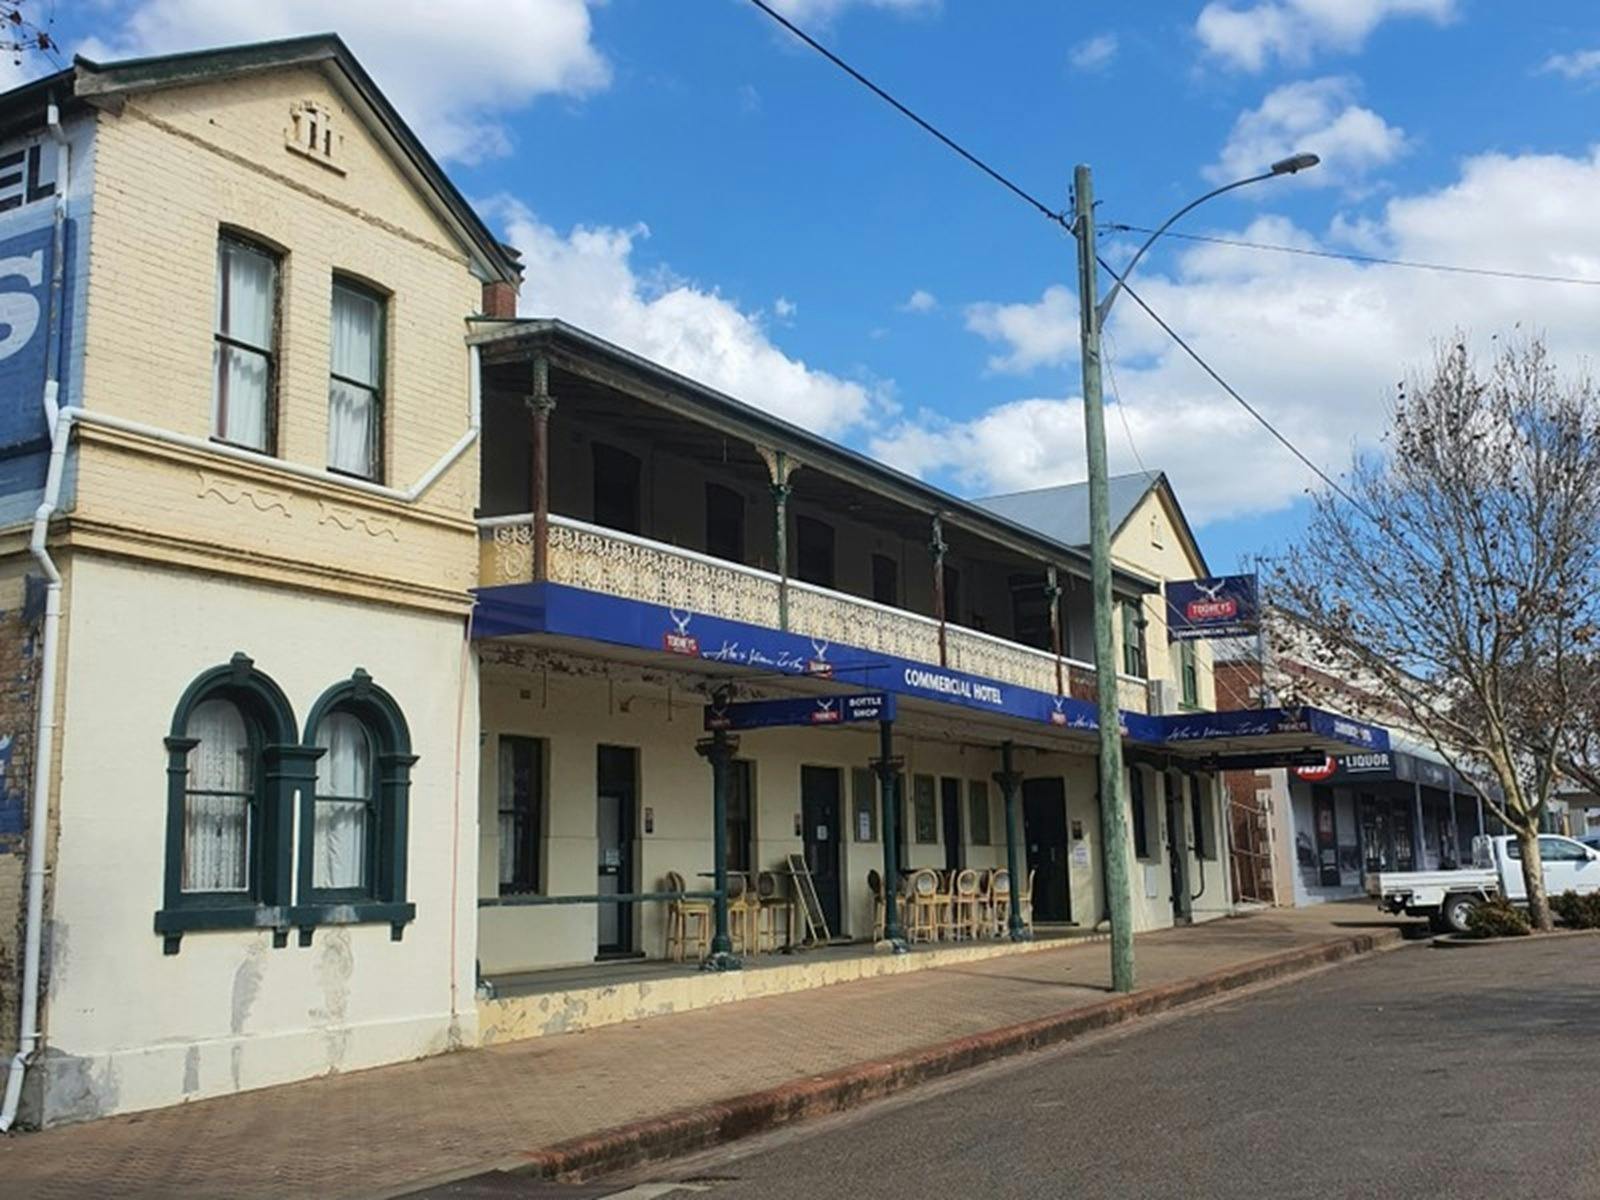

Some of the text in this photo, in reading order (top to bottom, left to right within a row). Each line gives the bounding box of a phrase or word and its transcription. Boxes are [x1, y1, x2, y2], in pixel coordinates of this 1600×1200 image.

[1192, 601, 1232, 616] TOOHEYS
[904, 668, 1003, 704] COMMERCIAL HOTEL
[848, 697, 882, 707] BOTTLE
[853, 708, 879, 718] SHOP
[1345, 753, 1390, 767] LIQUOR
